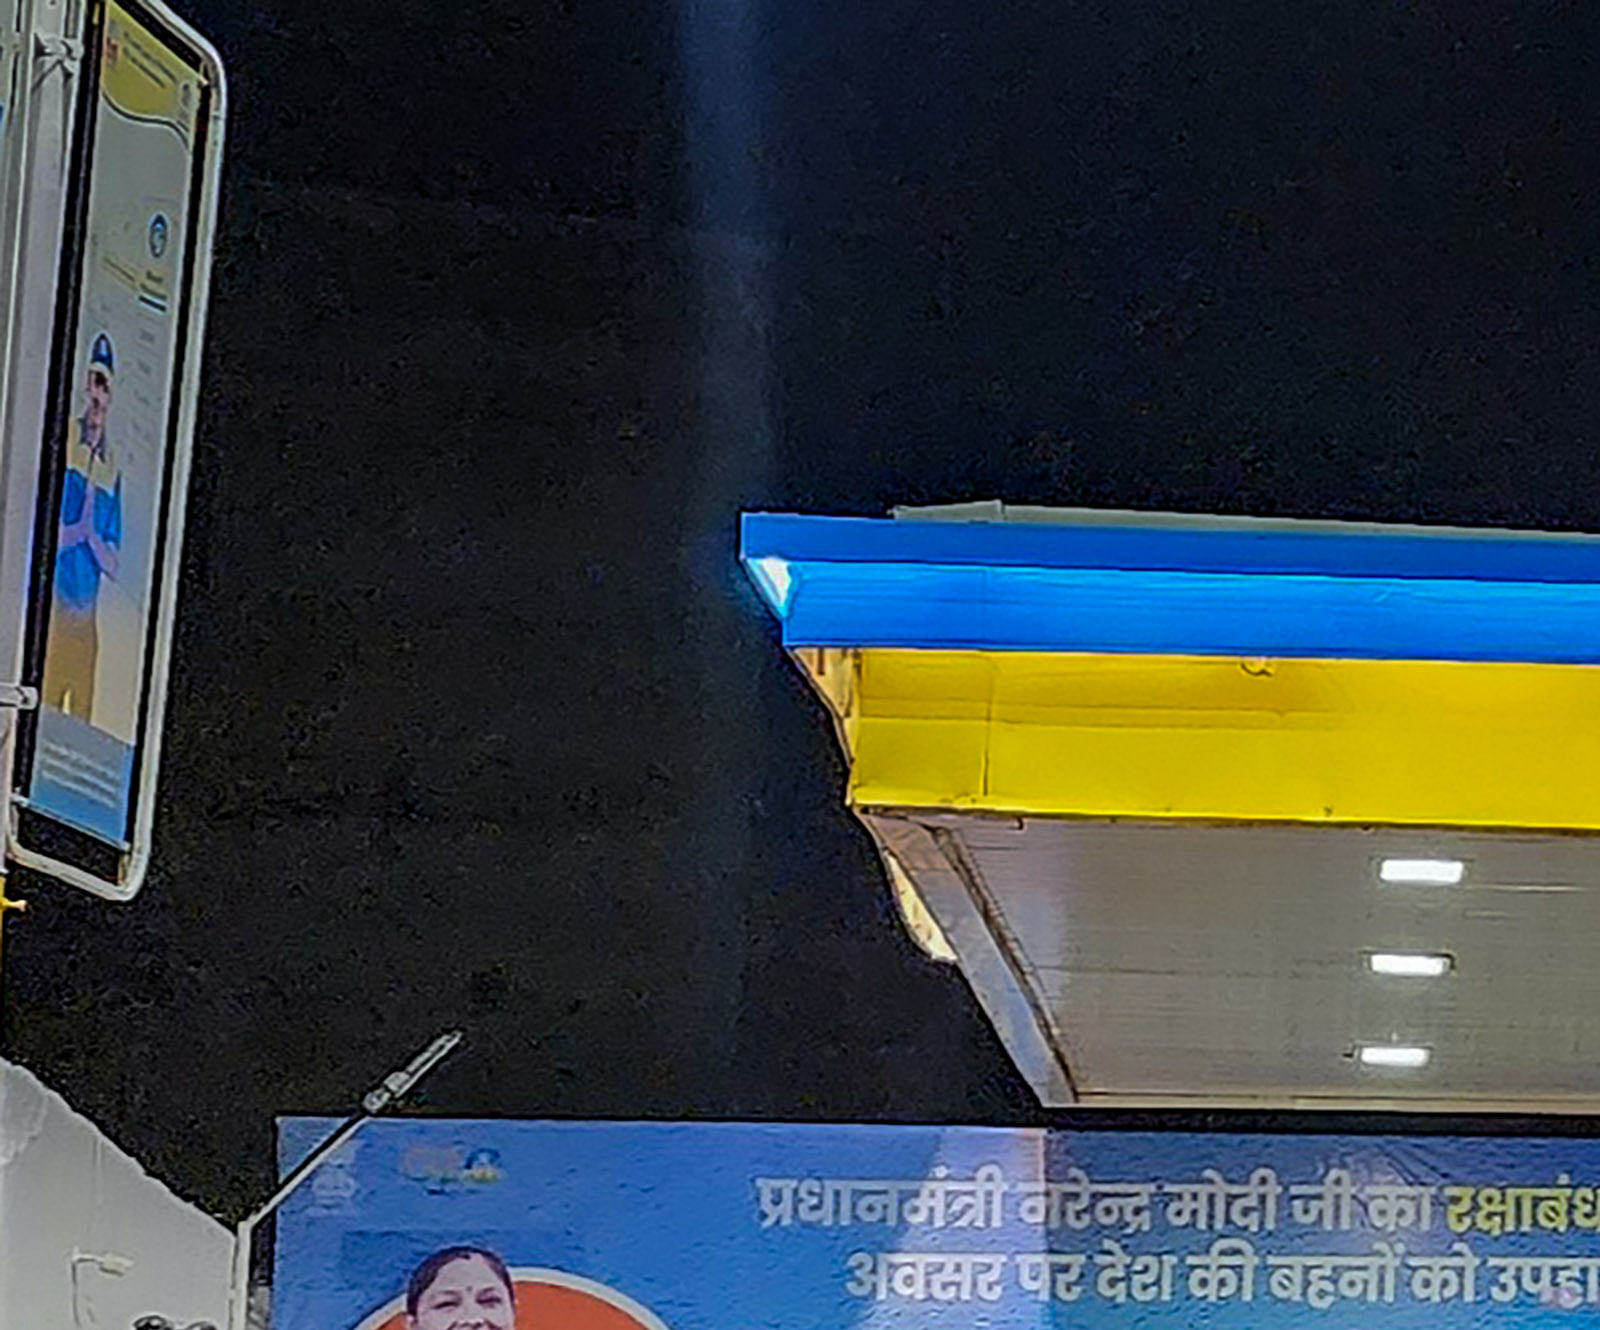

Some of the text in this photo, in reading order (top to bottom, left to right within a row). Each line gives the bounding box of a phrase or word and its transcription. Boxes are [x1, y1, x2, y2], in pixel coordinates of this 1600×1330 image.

[756, 1164, 1009, 1230] प्रधानमंत्री
[1020, 1168, 1156, 1233] नरेन्द्र
[1164, 1168, 1281, 1230] मोदी
[1289, 1168, 1356, 1231] जी
[1364, 1185, 1434, 1231] का
[845, 1252, 1008, 1302] अवसर
[1013, 1252, 1086, 1302] पर
[1093, 1240, 1177, 1302] देश
[1185, 1238, 1259, 1302] की
[1266, 1241, 1405, 1308] बहनों
[1408, 1243, 1481, 1302] को
